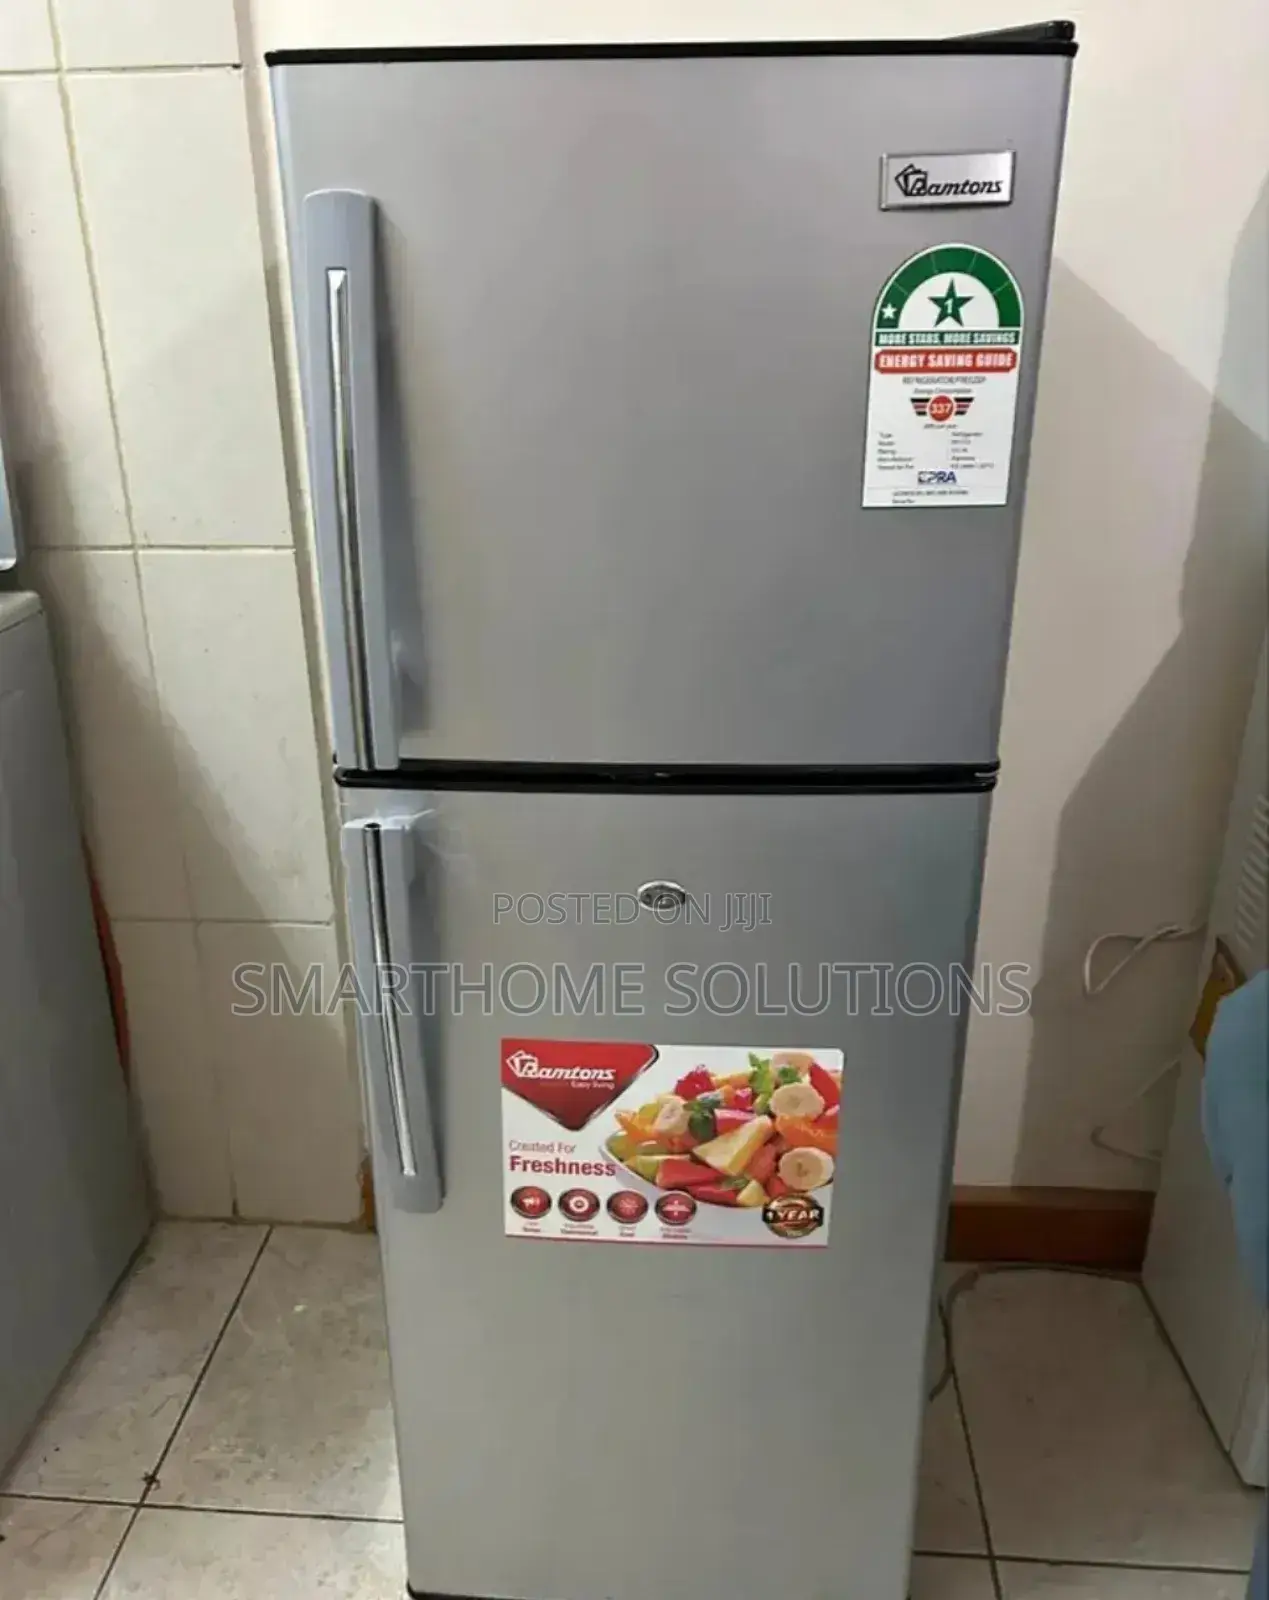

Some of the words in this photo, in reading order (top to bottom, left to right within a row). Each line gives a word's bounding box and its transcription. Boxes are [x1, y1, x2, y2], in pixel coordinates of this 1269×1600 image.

[908, 174, 1003, 196] Ramtons
[943, 298, 954, 314] 1
[879, 334, 906, 345] MORE
[943, 333, 971, 344] MORE
[973, 332, 1016, 343] SAVINGS
[880, 354, 924, 368] ENERGY
[927, 353, 973, 367] SAVING
[976, 352, 1014, 366] GUIDE
[520, 1060, 616, 1080] Ramtons
[509, 1139, 554, 1153] Created
[557, 1142, 576, 1154] For
[509, 1155, 616, 1176] Freshness
[776, 1209, 820, 1220] YEAR
